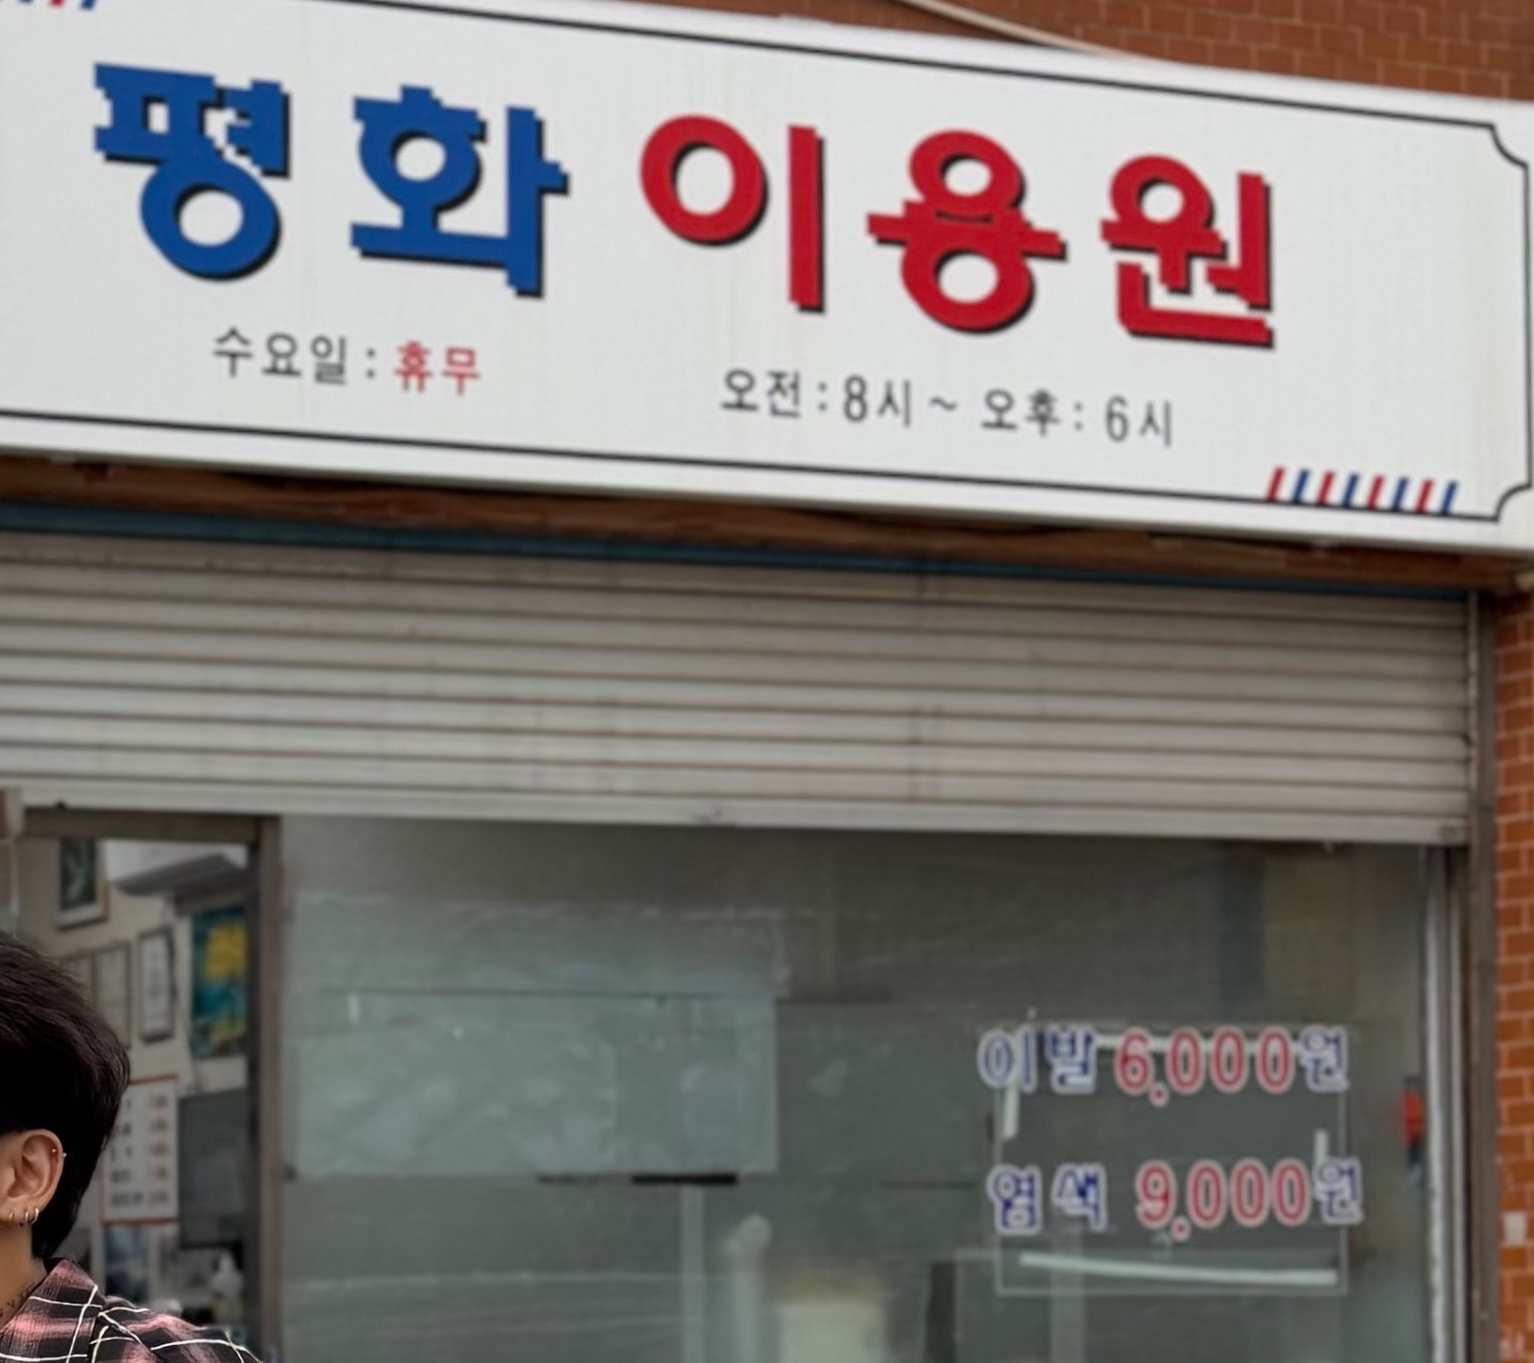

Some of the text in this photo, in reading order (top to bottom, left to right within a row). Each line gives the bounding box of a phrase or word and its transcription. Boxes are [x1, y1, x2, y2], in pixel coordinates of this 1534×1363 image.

[93, 62, 1276, 350] 평화 이용원
[979, 1028, 1096, 1093] 이발
[988, 1164, 1106, 1233] 염색
